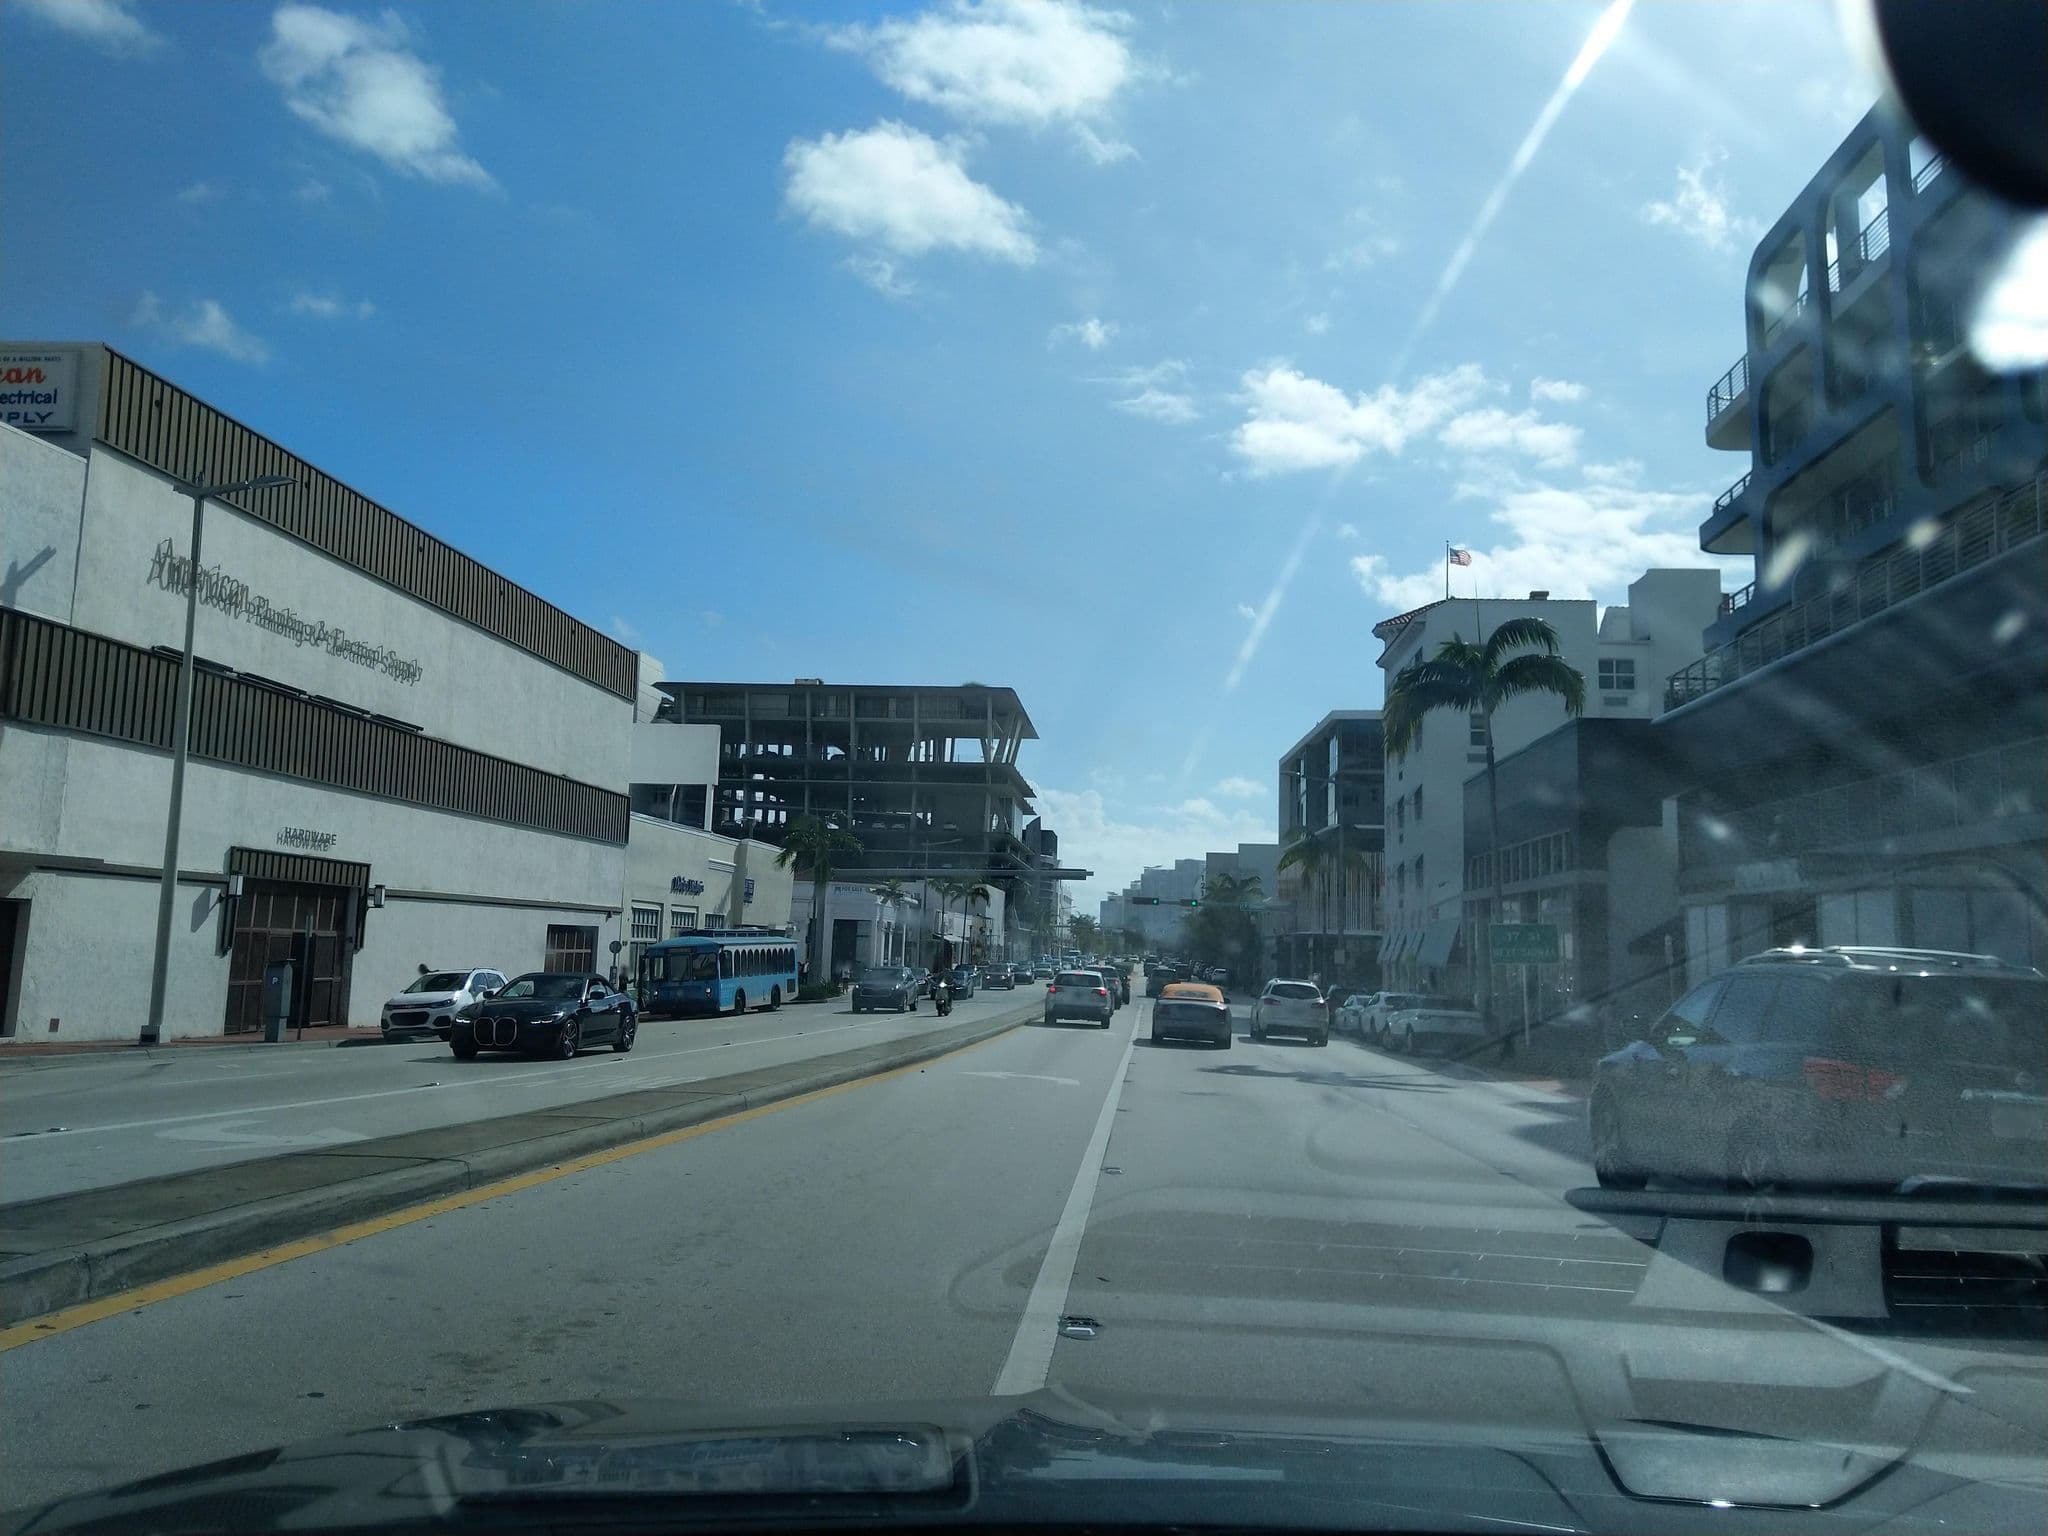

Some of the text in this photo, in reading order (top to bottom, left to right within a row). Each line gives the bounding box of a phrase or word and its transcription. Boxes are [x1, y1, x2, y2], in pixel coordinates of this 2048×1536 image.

[0, 411, 54, 424] PLY
[250, 596, 314, 646] Plumbing
[330, 628, 384, 668] Electrical
[281, 826, 337, 848] HARDWARE
